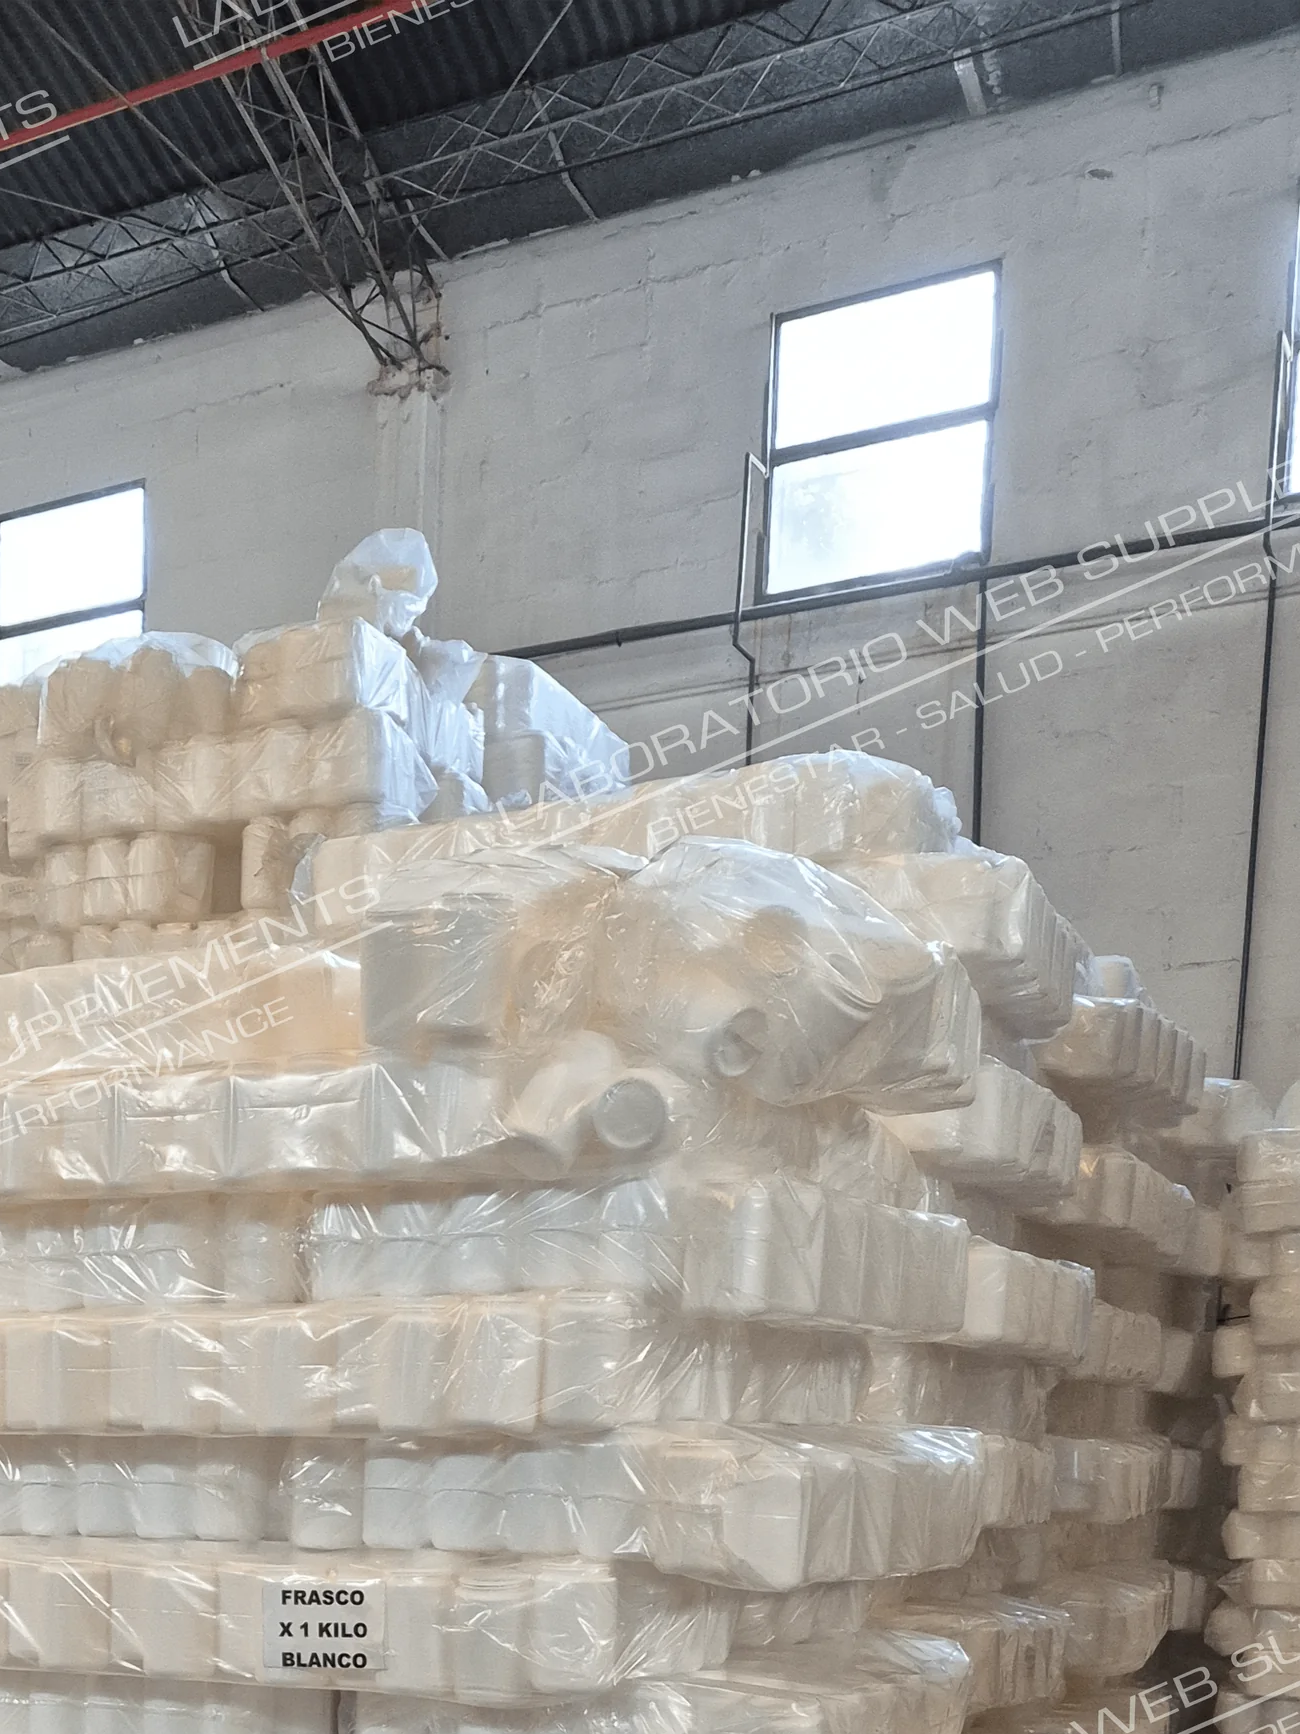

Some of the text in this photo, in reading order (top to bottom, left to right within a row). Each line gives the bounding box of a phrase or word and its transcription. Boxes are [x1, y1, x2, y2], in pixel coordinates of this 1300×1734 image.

[281, 1590, 364, 1605] FRASCO
[279, 1622, 367, 1638] X 1 KILO
[281, 1652, 367, 1668] BLANCO
